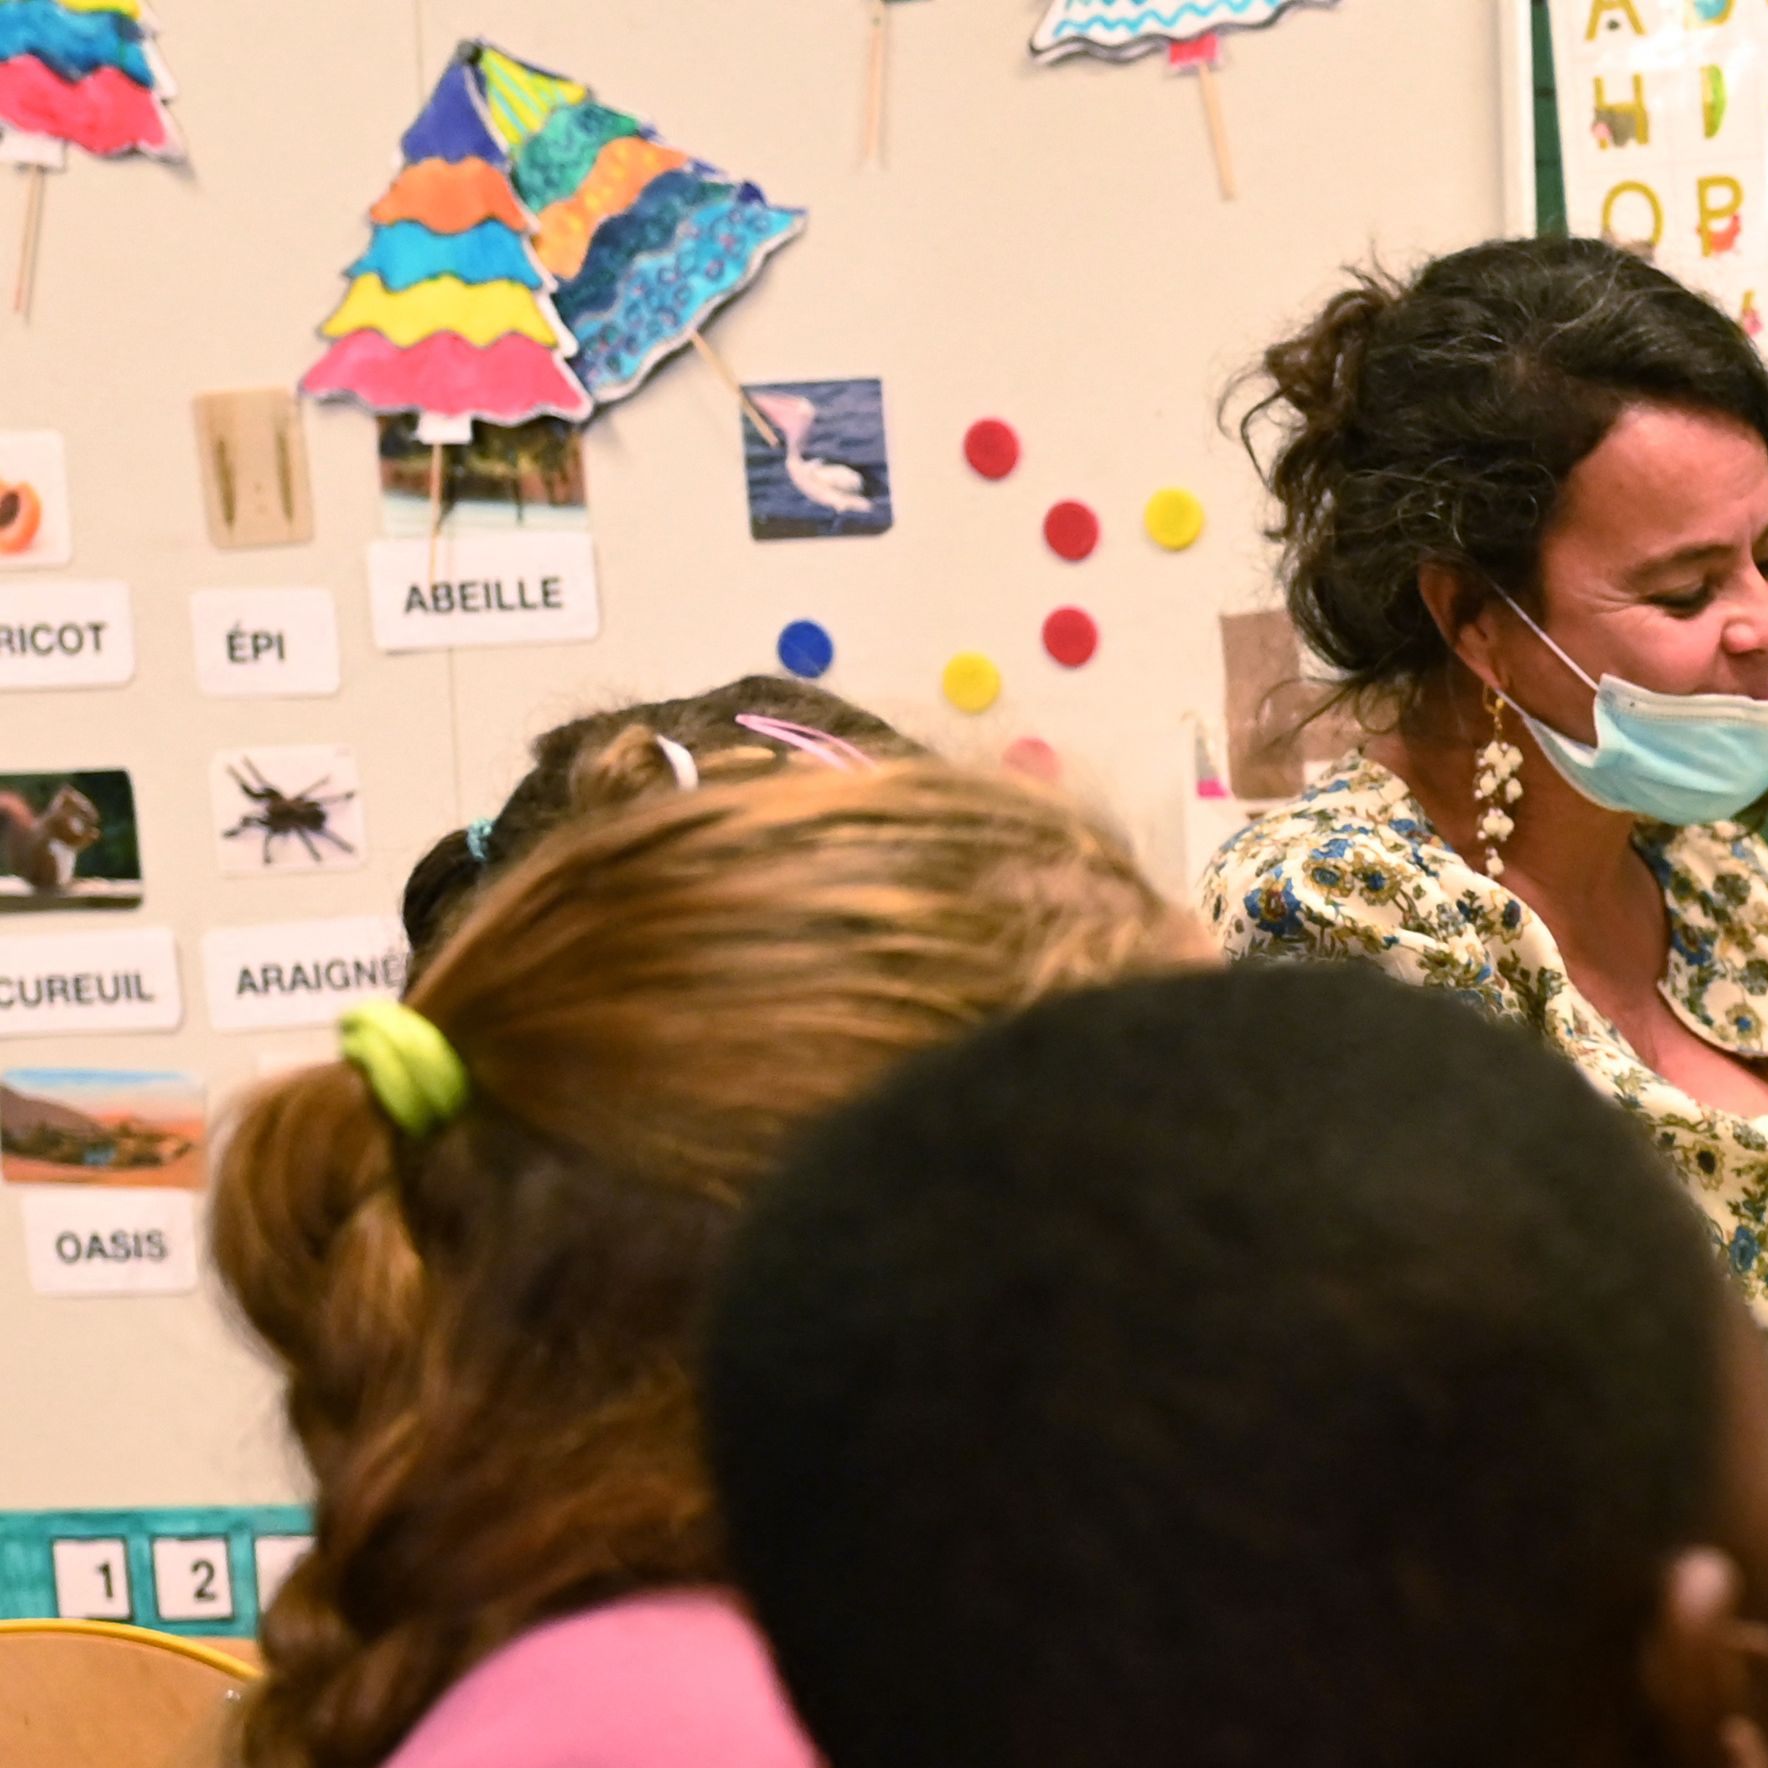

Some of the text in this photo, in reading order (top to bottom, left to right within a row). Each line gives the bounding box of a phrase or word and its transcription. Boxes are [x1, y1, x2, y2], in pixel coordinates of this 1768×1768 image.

[1593, 73, 1649, 149] H
[1697, 175, 1744, 256] P
[404, 576, 564, 614] ABEILLE
[226, 619, 285, 663] ÉPI
[55, 1230, 168, 1264] OASIS
[97, 1559, 217, 1601] 1 2
